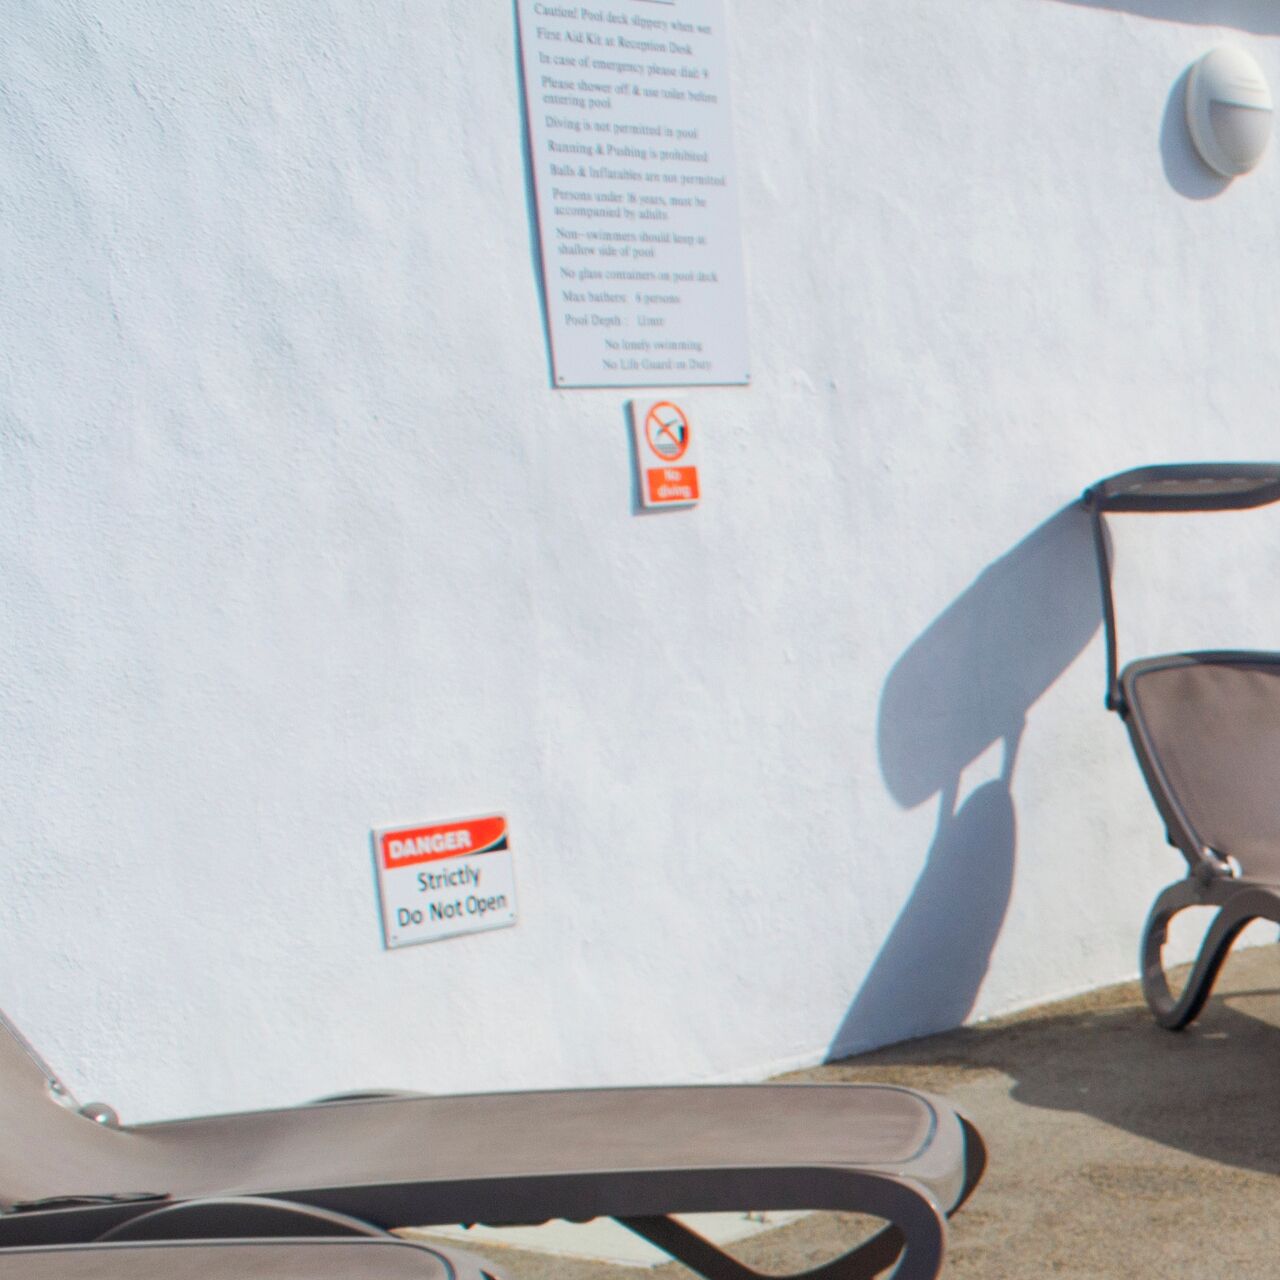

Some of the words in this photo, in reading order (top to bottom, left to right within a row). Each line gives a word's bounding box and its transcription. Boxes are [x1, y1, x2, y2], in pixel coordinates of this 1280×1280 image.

[535, 3, 577, 18] Caution!
[581, 8, 603, 22] Pool
[606, 11, 628, 24] deck
[631, 15, 667, 31] slippery
[671, 19, 694, 33] when
[698, 25, 712, 35] wet
[537, 27, 561, 40] First
[566, 30, 583, 43] Aid
[586, 32, 602, 45] Kit
[605, 37, 615, 47] at
[618, 36, 667, 52] Reception
[670, 42, 694, 55] Desk
[539, 52, 550, 63] In
[553, 56, 575, 66] case
[578, 56, 590, 67] of
[592, 60, 644, 74] emergency
[648, 63, 677, 77] please
[542, 76, 574, 89] Please
[578, 79, 612, 93] shower
[615, 82, 630, 95] off
[632, 85, 641, 96] &
[644, 89, 660, 98] use
[688, 90, 718, 104] before
[542, 94, 586, 109] entering
[589, 96, 612, 109] pool
[546, 115, 581, 132] Diving
[583, 119, 592, 130] is
[594, 120, 610, 132] not
[613, 122, 662, 136] permitted
[665, 125, 674, 137] in
[677, 127, 698, 140] pool
[548, 139, 593, 157] Running
[597, 142, 604, 155] &
[607, 143, 648, 160] Pushing
[650, 147, 659, 159] is
[661, 148, 709, 162] prohibited
[550, 163, 576, 177] Balls
[578, 165, 586, 178] &
[589, 165, 643, 181] Inflatables
[646, 172, 661, 183] are
[663, 173, 678, 184] not
[681, 174, 727, 187] permitted
[553, 187, 593, 200] Persons
[596, 190, 624, 202] under
[670, 197, 693, 208] must
[695, 195, 707, 208] be
[554, 206, 622, 220] accompanied
[624, 208, 636, 221] by
[639, 209, 669, 221] adults
[640, 230, 672, 243] should
[673, 231, 695, 247] keep
[558, 243, 595, 256] shallow
[599, 244, 617, 257] side
[620, 245, 630, 257] of
[633, 247, 656, 260] pool
[560, 266, 576, 280] No
[579, 267, 602, 282] glass
[605, 270, 657, 281] containers
[658, 271, 671, 281] on
[673, 270, 695, 284] pool
[697, 269, 719, 283] deck
[562, 289, 586, 303] Max
[644, 293, 681, 305] persons
[564, 313, 588, 327] Pool
[605, 338, 619, 350] No
[622, 339, 650, 352] lonely
[653, 340, 704, 353] swimming
[603, 358, 618, 370] No
[621, 358, 640, 370] Life
[642, 358, 672, 371] Guard
[689, 359, 713, 374] Duty
[388, 829, 473, 860] DANGER
[417, 864, 481, 892] Strictly
[396, 906, 424, 928] Do
[429, 901, 463, 921] Not
[465, 894, 507, 918] Open
